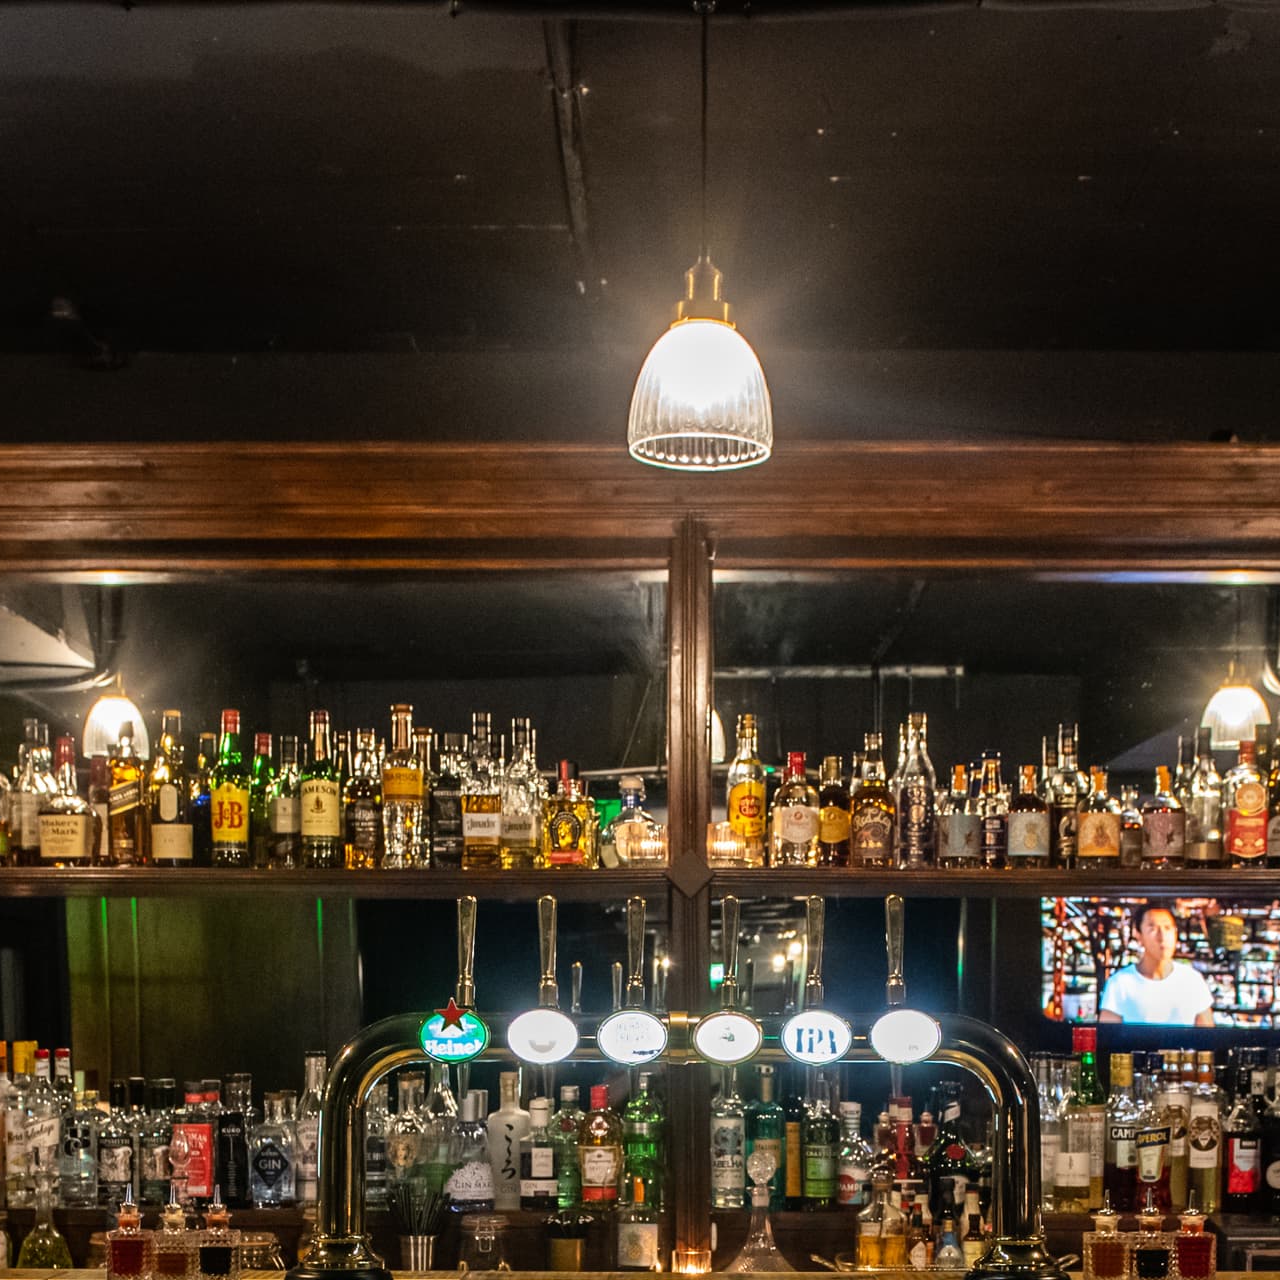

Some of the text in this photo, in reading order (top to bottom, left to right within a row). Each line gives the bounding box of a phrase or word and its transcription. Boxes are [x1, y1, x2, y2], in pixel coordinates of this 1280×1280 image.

[302, 785, 337, 796] JAMESON
[41, 819, 79, 827] Maker's
[1137, 1131, 1167, 1143] APEROL
[258, 1158, 282, 1170] GIN
[455, 1181, 472, 1189] GIN
